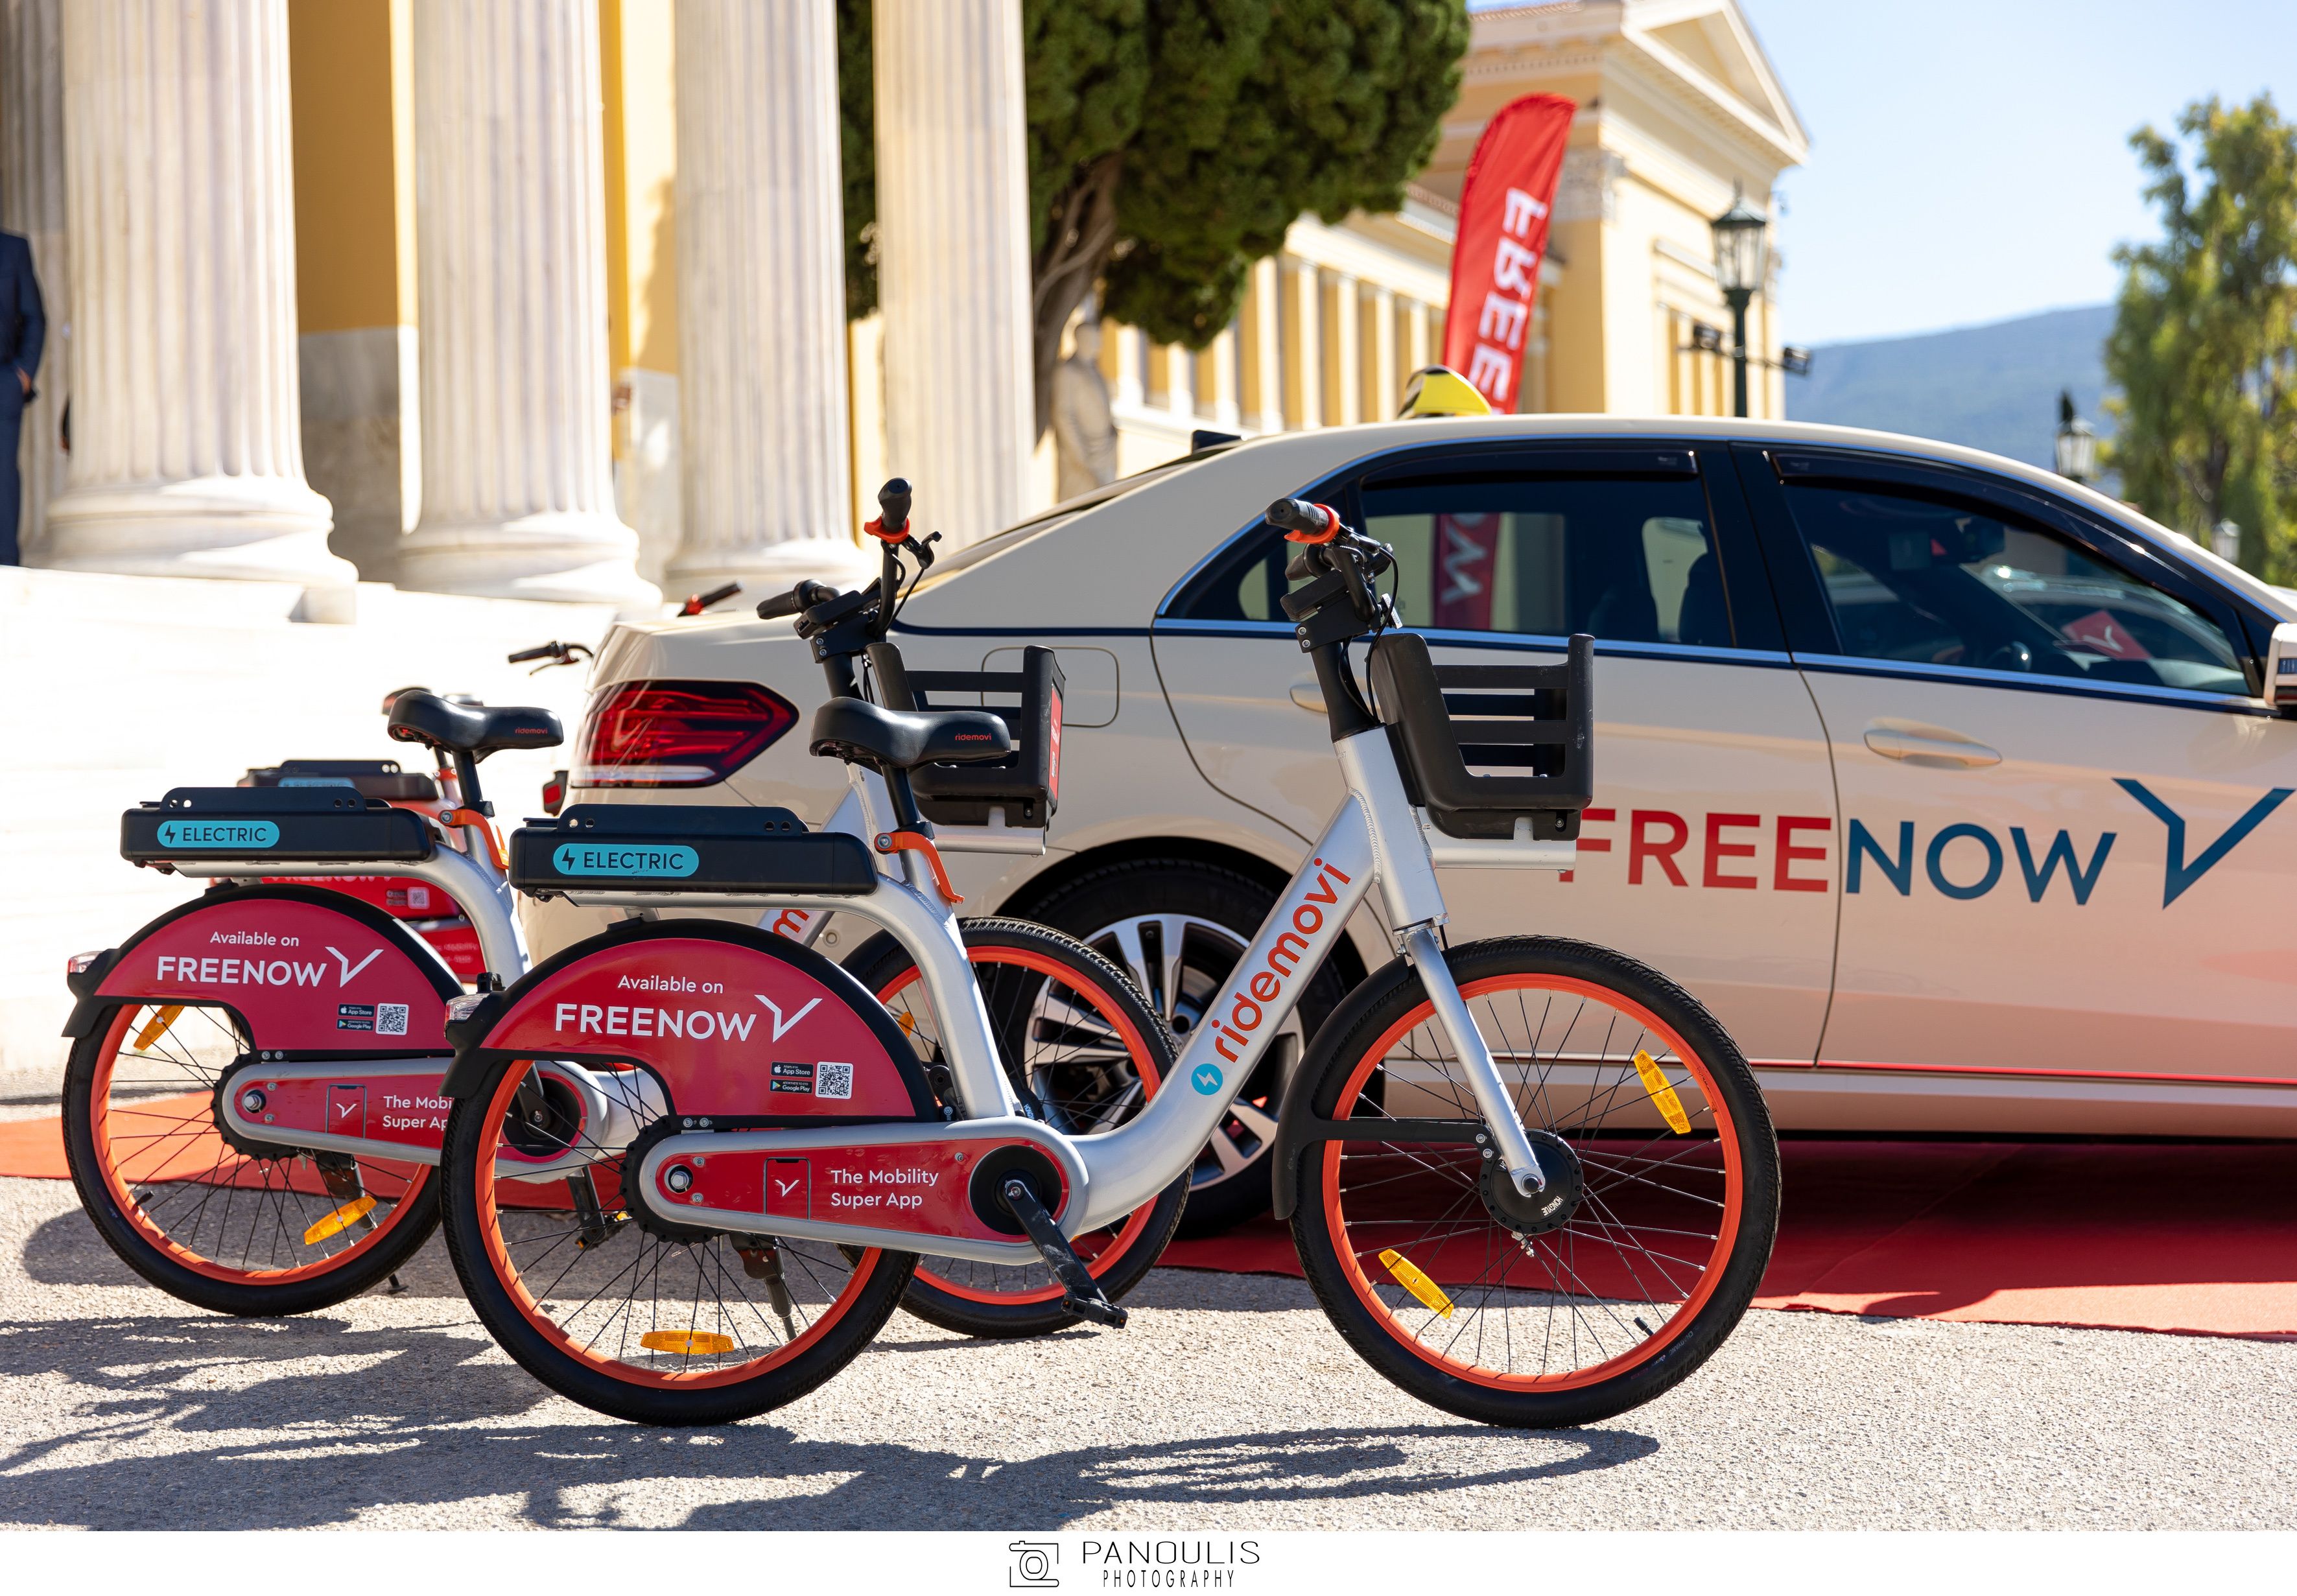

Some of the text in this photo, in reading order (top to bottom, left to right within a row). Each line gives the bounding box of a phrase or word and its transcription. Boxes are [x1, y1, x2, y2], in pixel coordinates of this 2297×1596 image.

[183, 827, 266, 842] ELECTRIC
[583, 851, 684, 871] ELECTRIC
[209, 931, 299, 946] Available on
[1212, 858, 1350, 1062] ridemovi
[157, 956, 327, 987] FREENOW
[617, 975, 724, 994] Available on
[555, 1003, 757, 1042] FREENOW
[383, 1094, 452, 1109] The Mobi
[383, 1115, 449, 1131] Super Ap
[830, 1169, 939, 1187] The Mobility
[830, 1192, 923, 1210] Super App
[1541, 1195, 1564, 1216] HONGYUE
